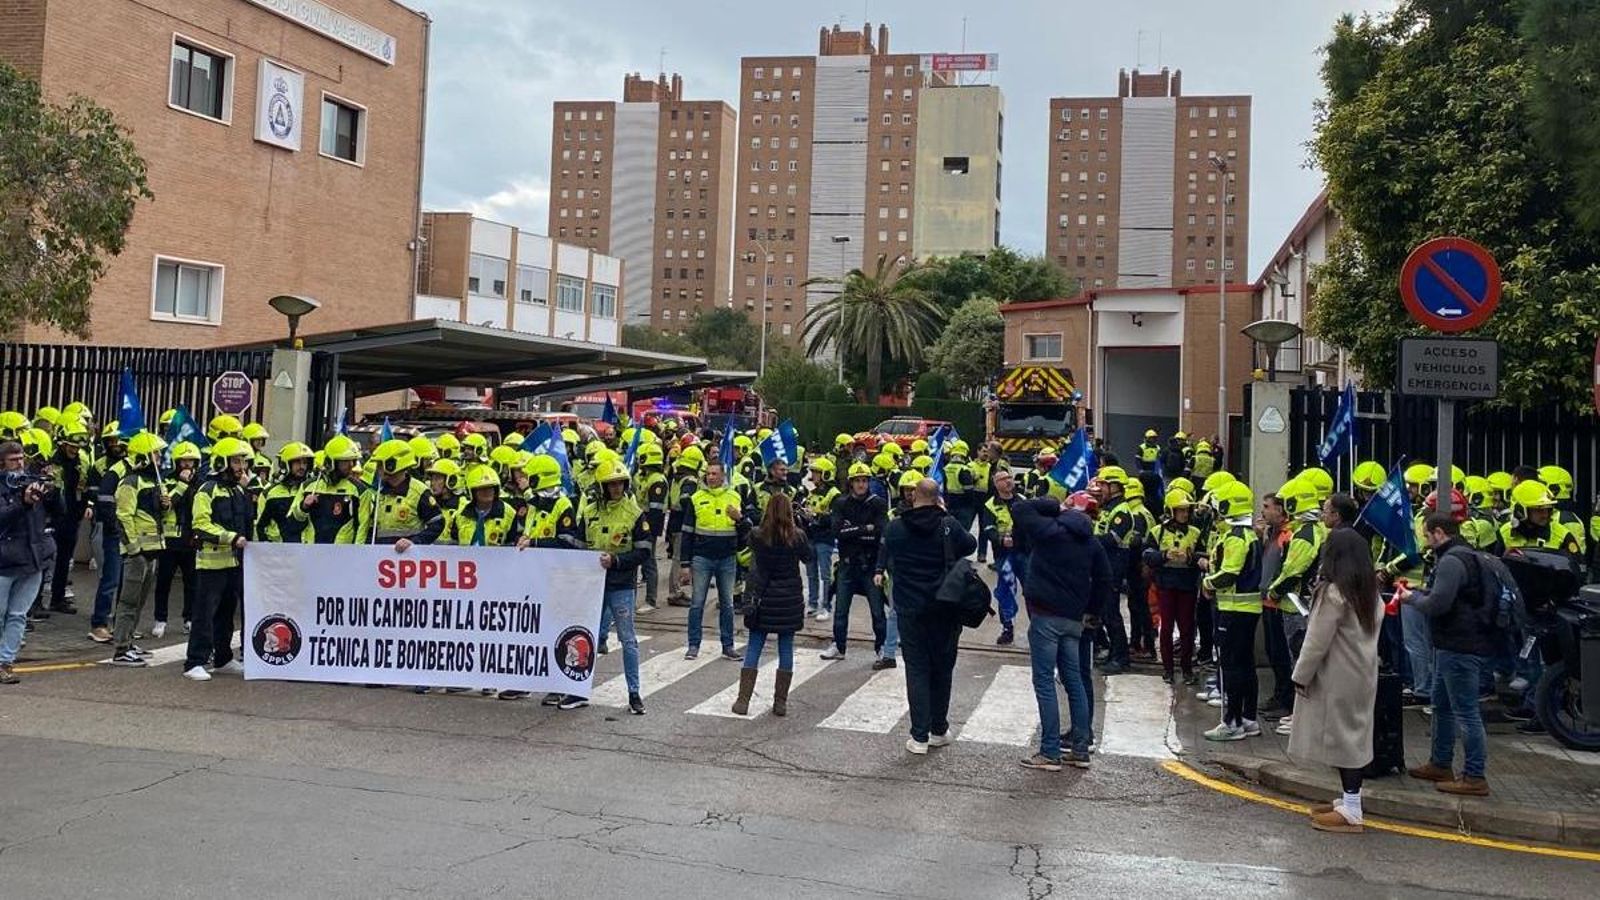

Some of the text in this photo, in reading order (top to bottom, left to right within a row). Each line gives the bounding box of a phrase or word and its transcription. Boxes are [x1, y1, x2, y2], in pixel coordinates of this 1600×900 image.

[1424, 347, 1477, 358] ACCESO
[1415, 362, 1486, 375] VEHICULOS
[222, 377, 245, 389] STOP
[378, 560, 477, 590] SPPLB
[316, 595, 541, 633] POR UN CAMBIO EN LA GESTIÓN
[262, 652, 294, 665] SPPLB
[309, 629, 548, 677] TÉCNICA DE BOMBEROS VALENCIA
[564, 666, 590, 680] SPPLB
